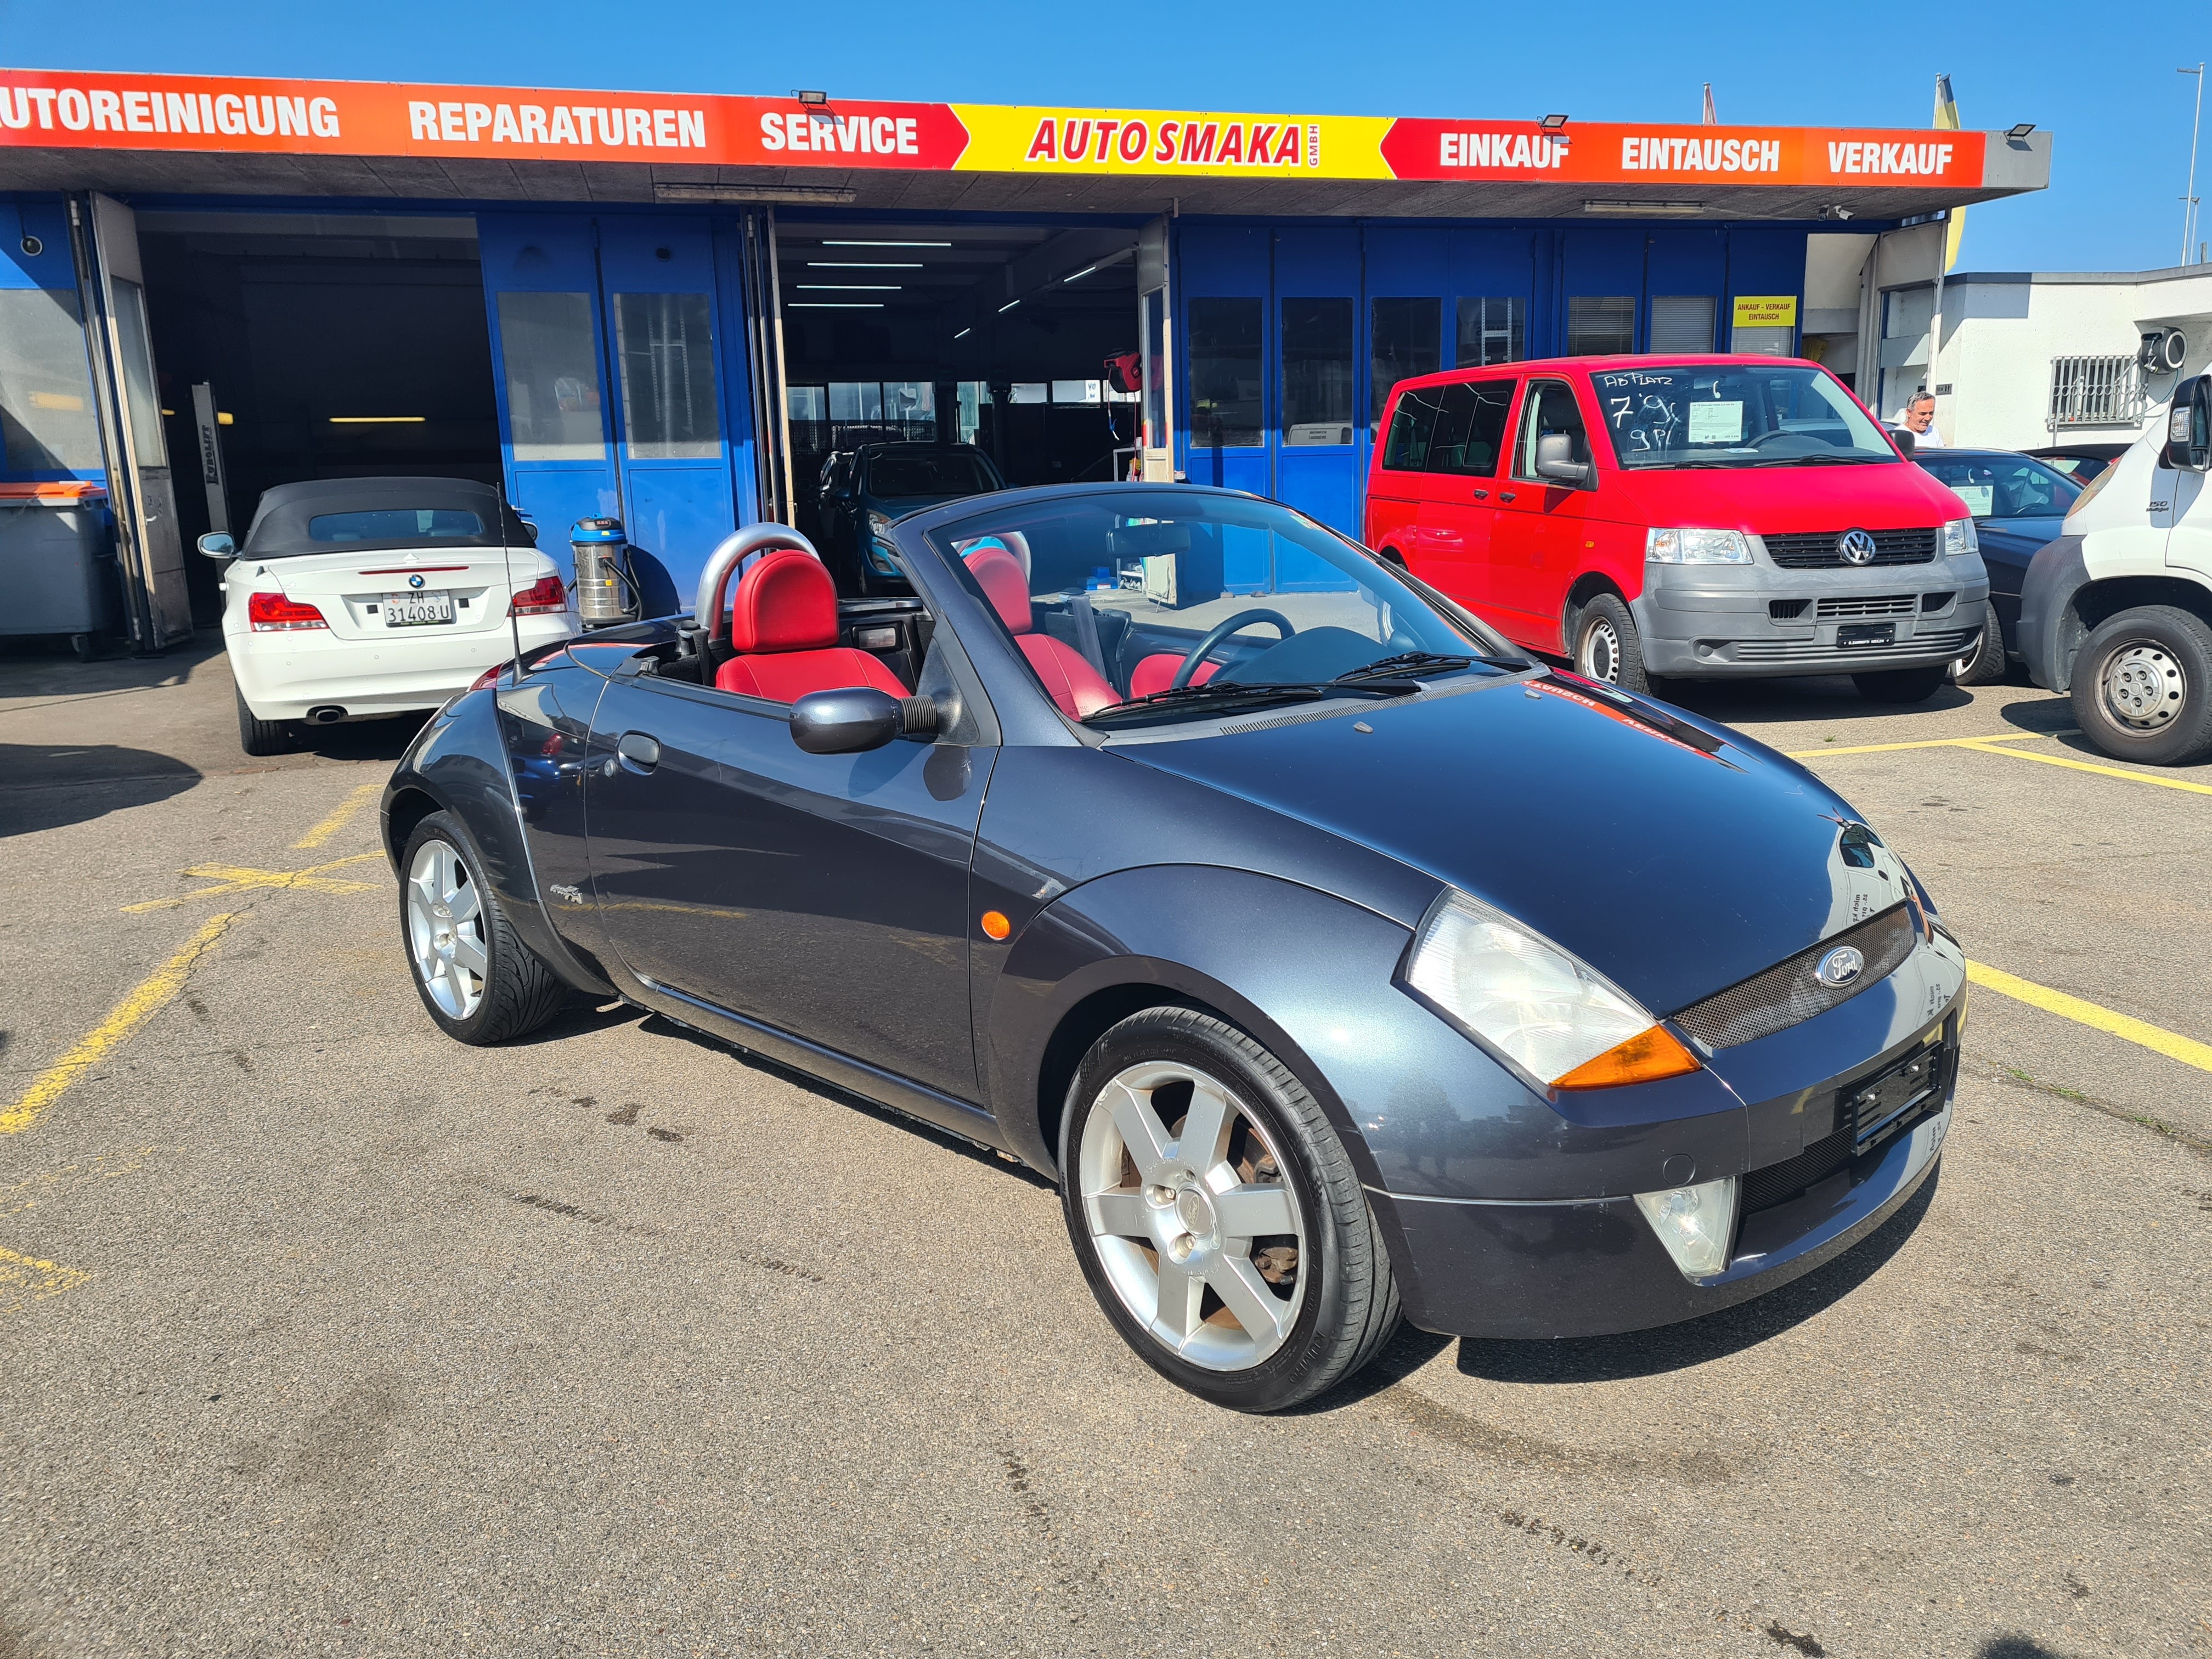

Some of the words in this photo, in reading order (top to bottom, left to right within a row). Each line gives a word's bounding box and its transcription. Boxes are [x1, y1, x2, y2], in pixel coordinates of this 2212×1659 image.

[0, 86, 340, 138] UTOREINIGUNG
[408, 101, 706, 148] REPARATUREN
[760, 112, 918, 154] SERVICE
[1026, 117, 1150, 162] AUTO
[1155, 121, 1302, 165] SMAKA
[1309, 124, 1320, 167] GMBH
[1440, 133, 1569, 168] EINKAUF
[1621, 137, 1779, 172] EINTAUSCH
[1828, 141, 1953, 175] VERKAUF
[408, 591, 425, 604] ZH
[1832, 952, 1858, 979] Ford
